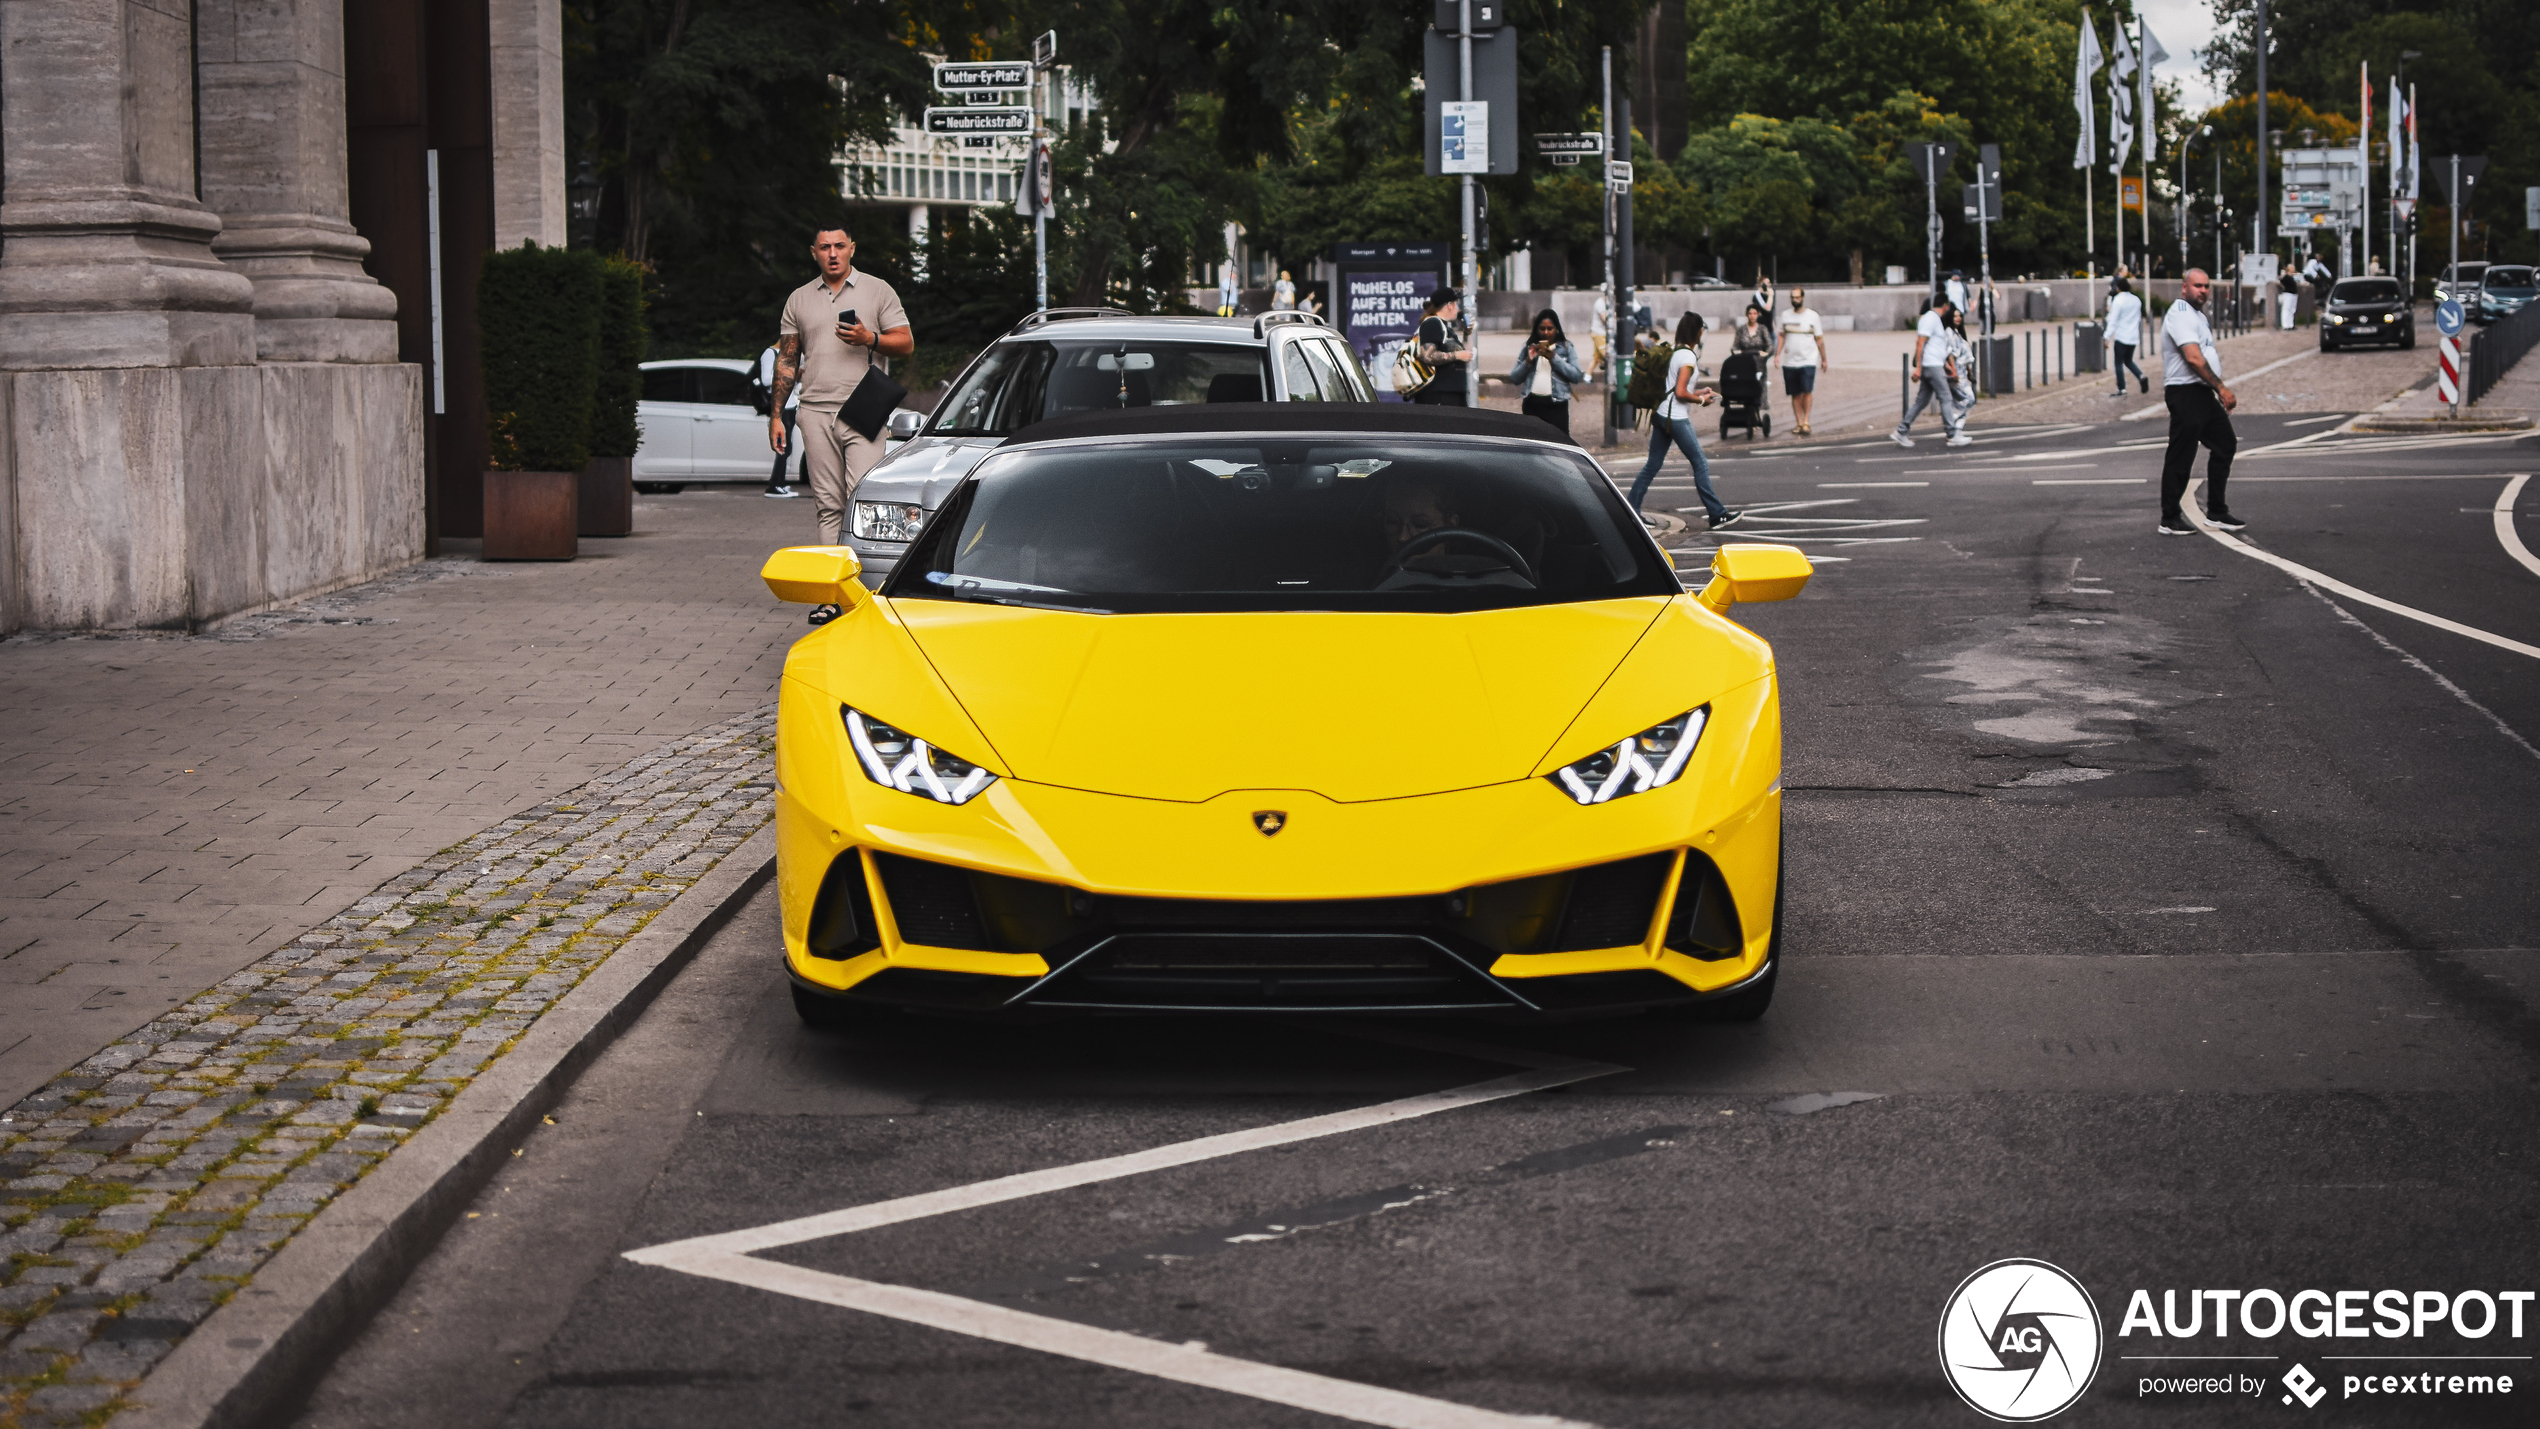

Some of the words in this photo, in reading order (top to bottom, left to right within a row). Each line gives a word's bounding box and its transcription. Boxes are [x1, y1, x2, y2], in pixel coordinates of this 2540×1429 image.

[944, 70, 1021, 85] Mutter-Ey-Platz
[946, 115, 1023, 128] Neubrückstraße
[1351, 297, 1387, 310] AUFS
[1390, 296, 1431, 310] KLIM
[1351, 312, 1410, 326] ACHTEN.
